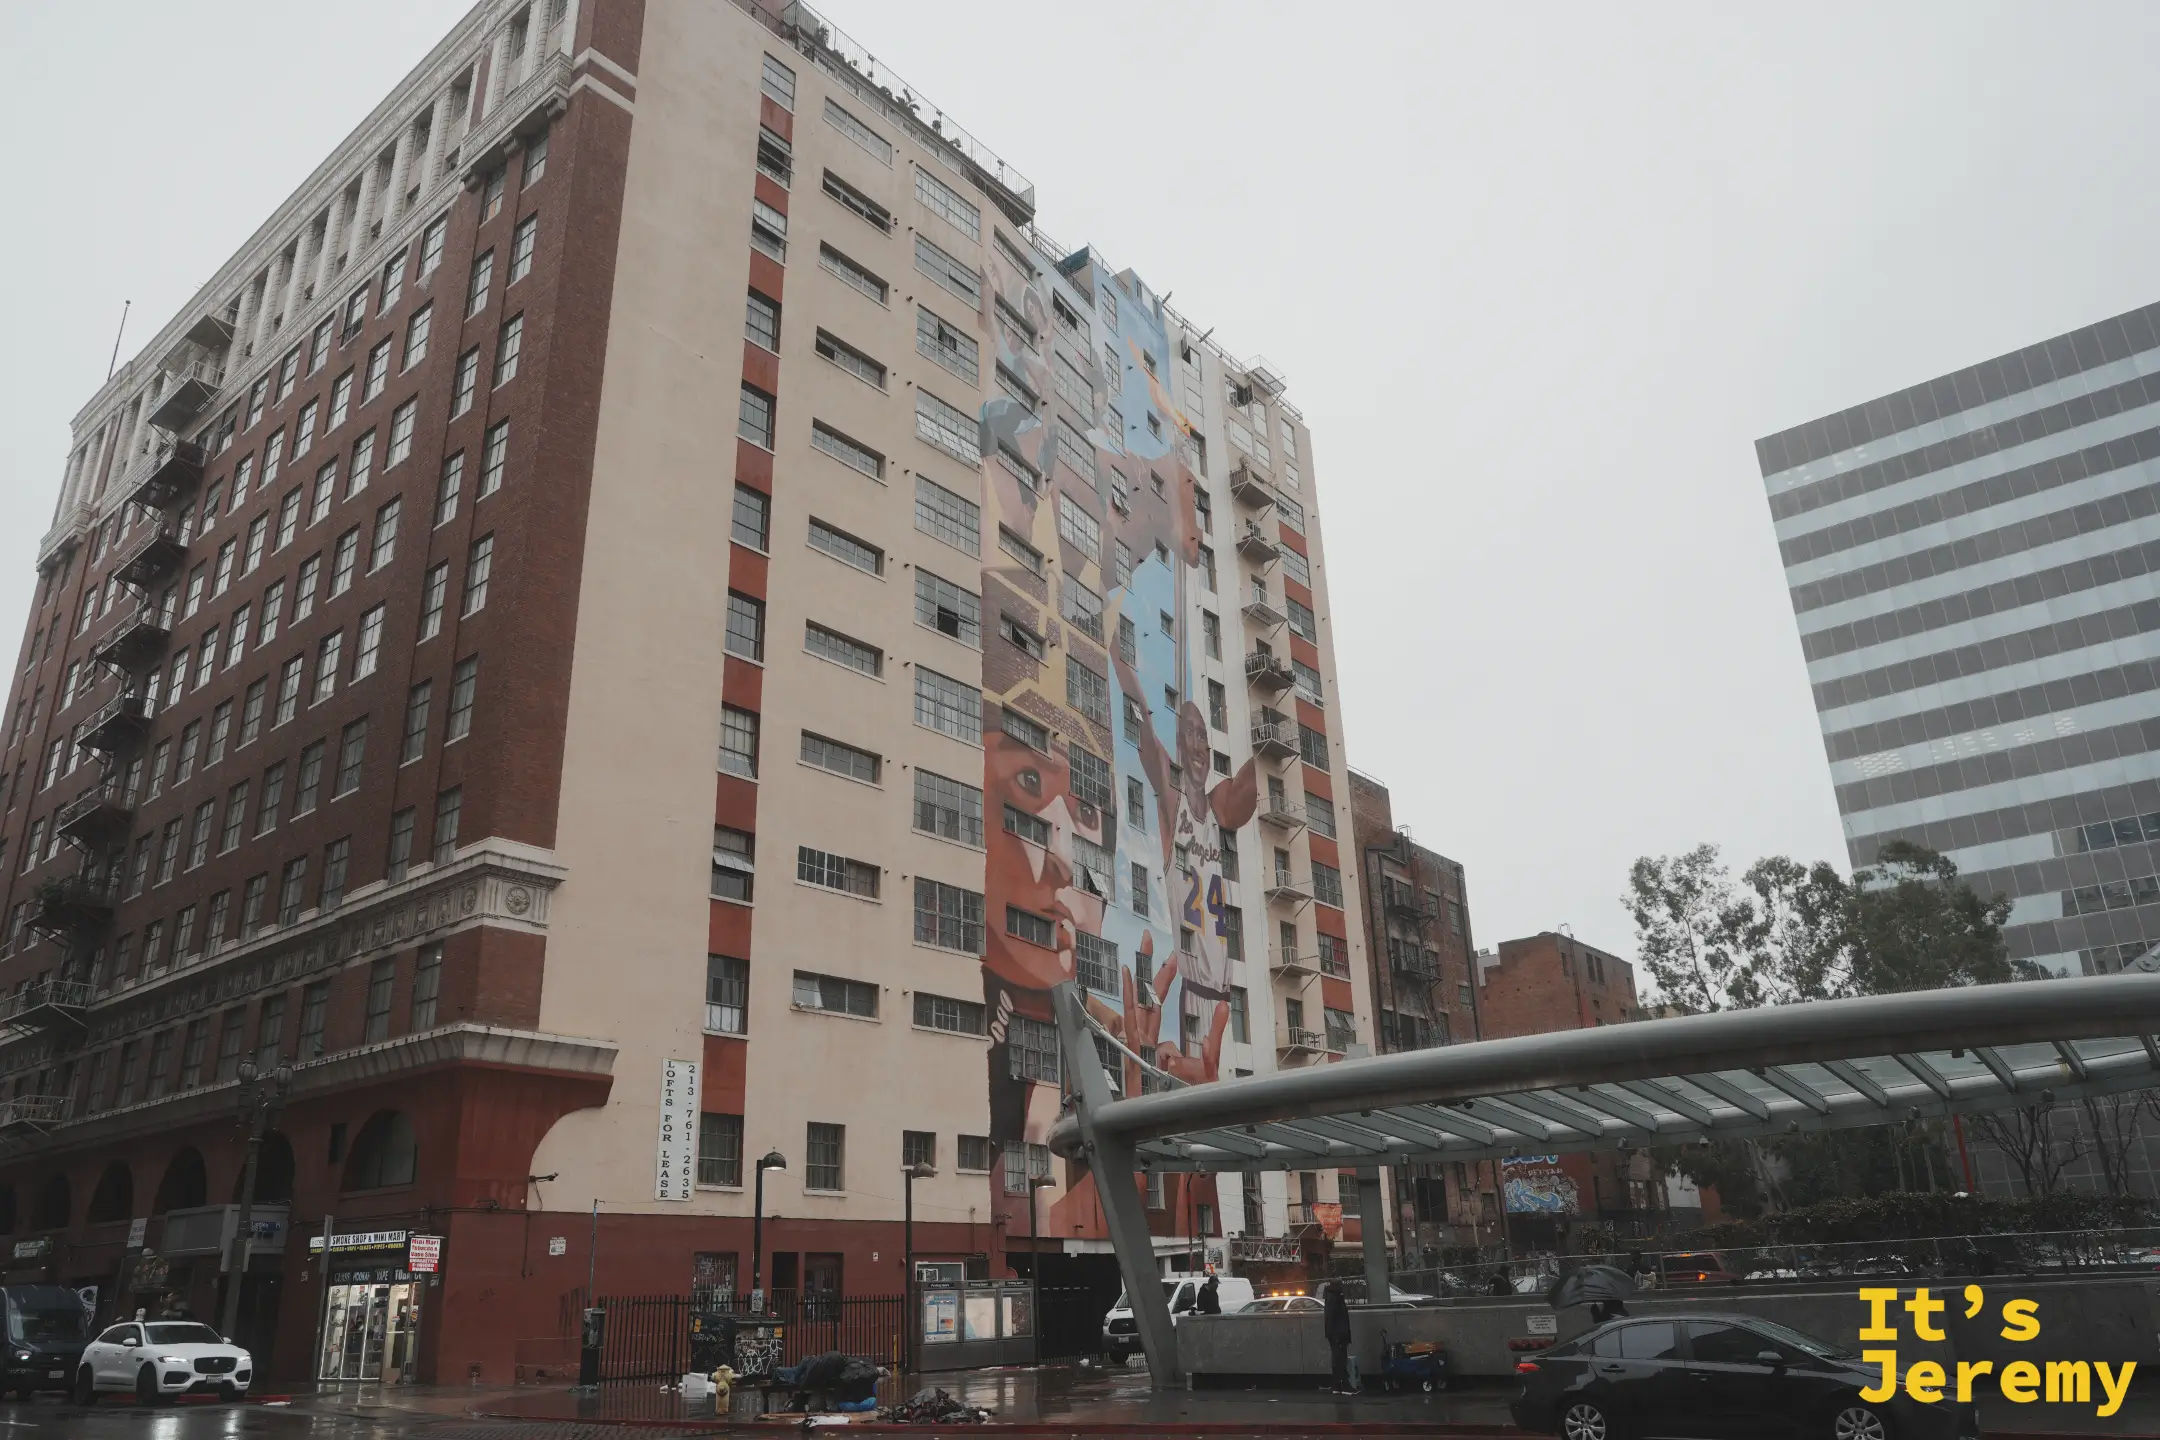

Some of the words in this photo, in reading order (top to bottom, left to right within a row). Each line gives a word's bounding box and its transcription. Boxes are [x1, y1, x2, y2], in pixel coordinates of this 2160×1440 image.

[1182, 866, 1228, 945] 24
[665, 1061, 675, 1106] LOFTS
[662, 1114, 672, 1142] FOR
[681, 1065, 695, 1199] 213-761-2635
[659, 1150, 670, 1198] LEASE
[332, 1234, 351, 1246] SMOKE
[352, 1233, 367, 1244] SHOP
[373, 1232, 387, 1243] MINI
[387, 1231, 404, 1242] MART
